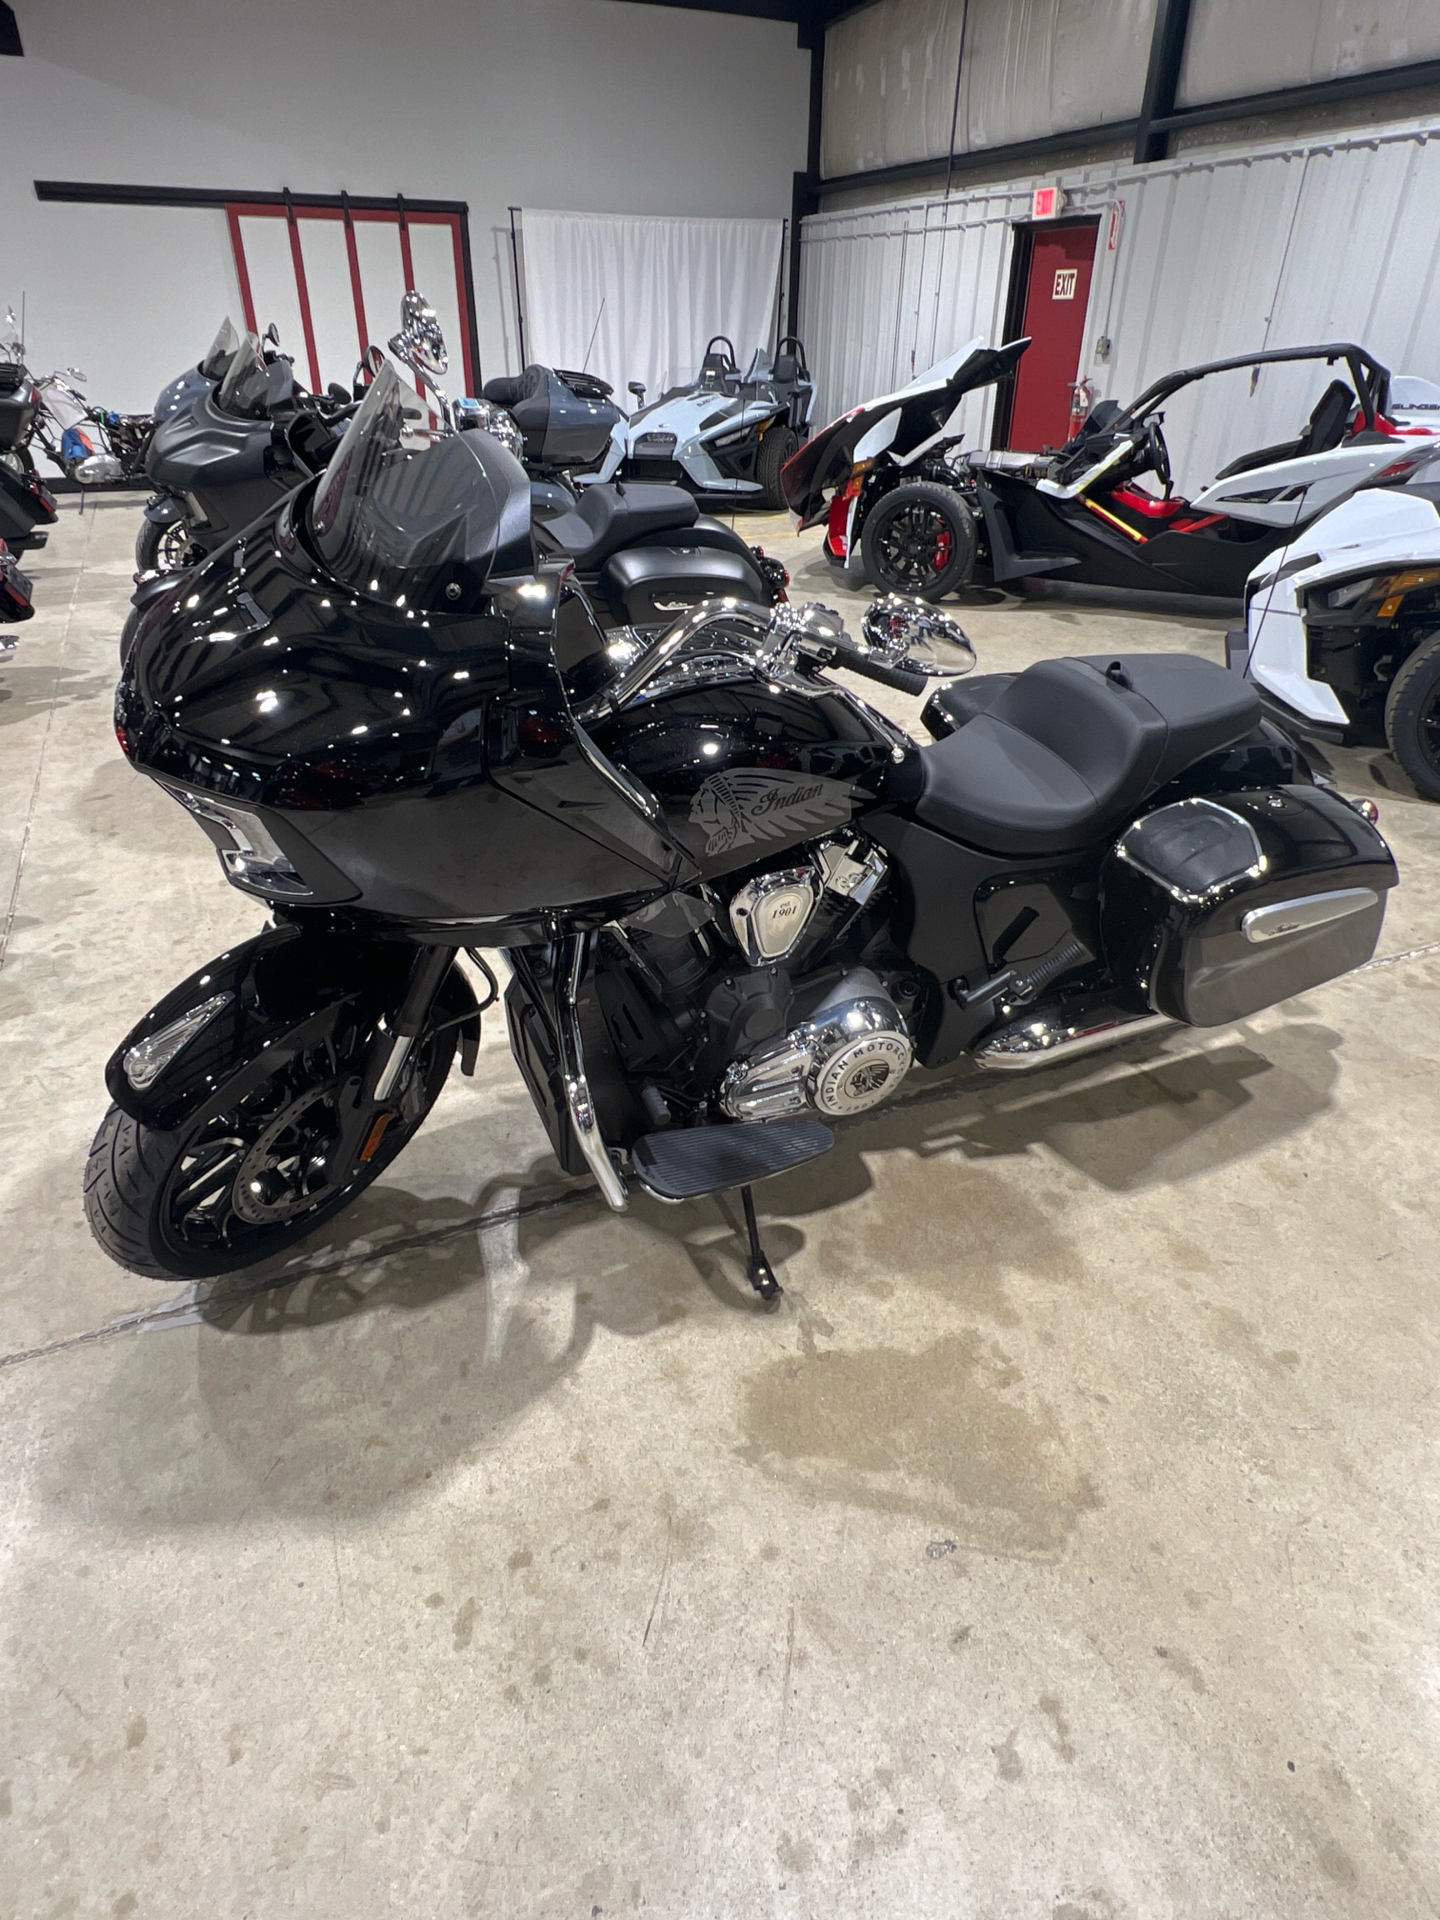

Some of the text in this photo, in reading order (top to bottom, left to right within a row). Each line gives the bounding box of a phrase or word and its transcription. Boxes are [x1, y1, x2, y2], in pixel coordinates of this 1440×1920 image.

[1036, 189, 1054, 216] EXIT
[1054, 273, 1076, 296] EXIT
[750, 783, 824, 817] Indian
[771, 905, 797, 919] 1901
[825, 1060, 849, 1107] INDIAN
